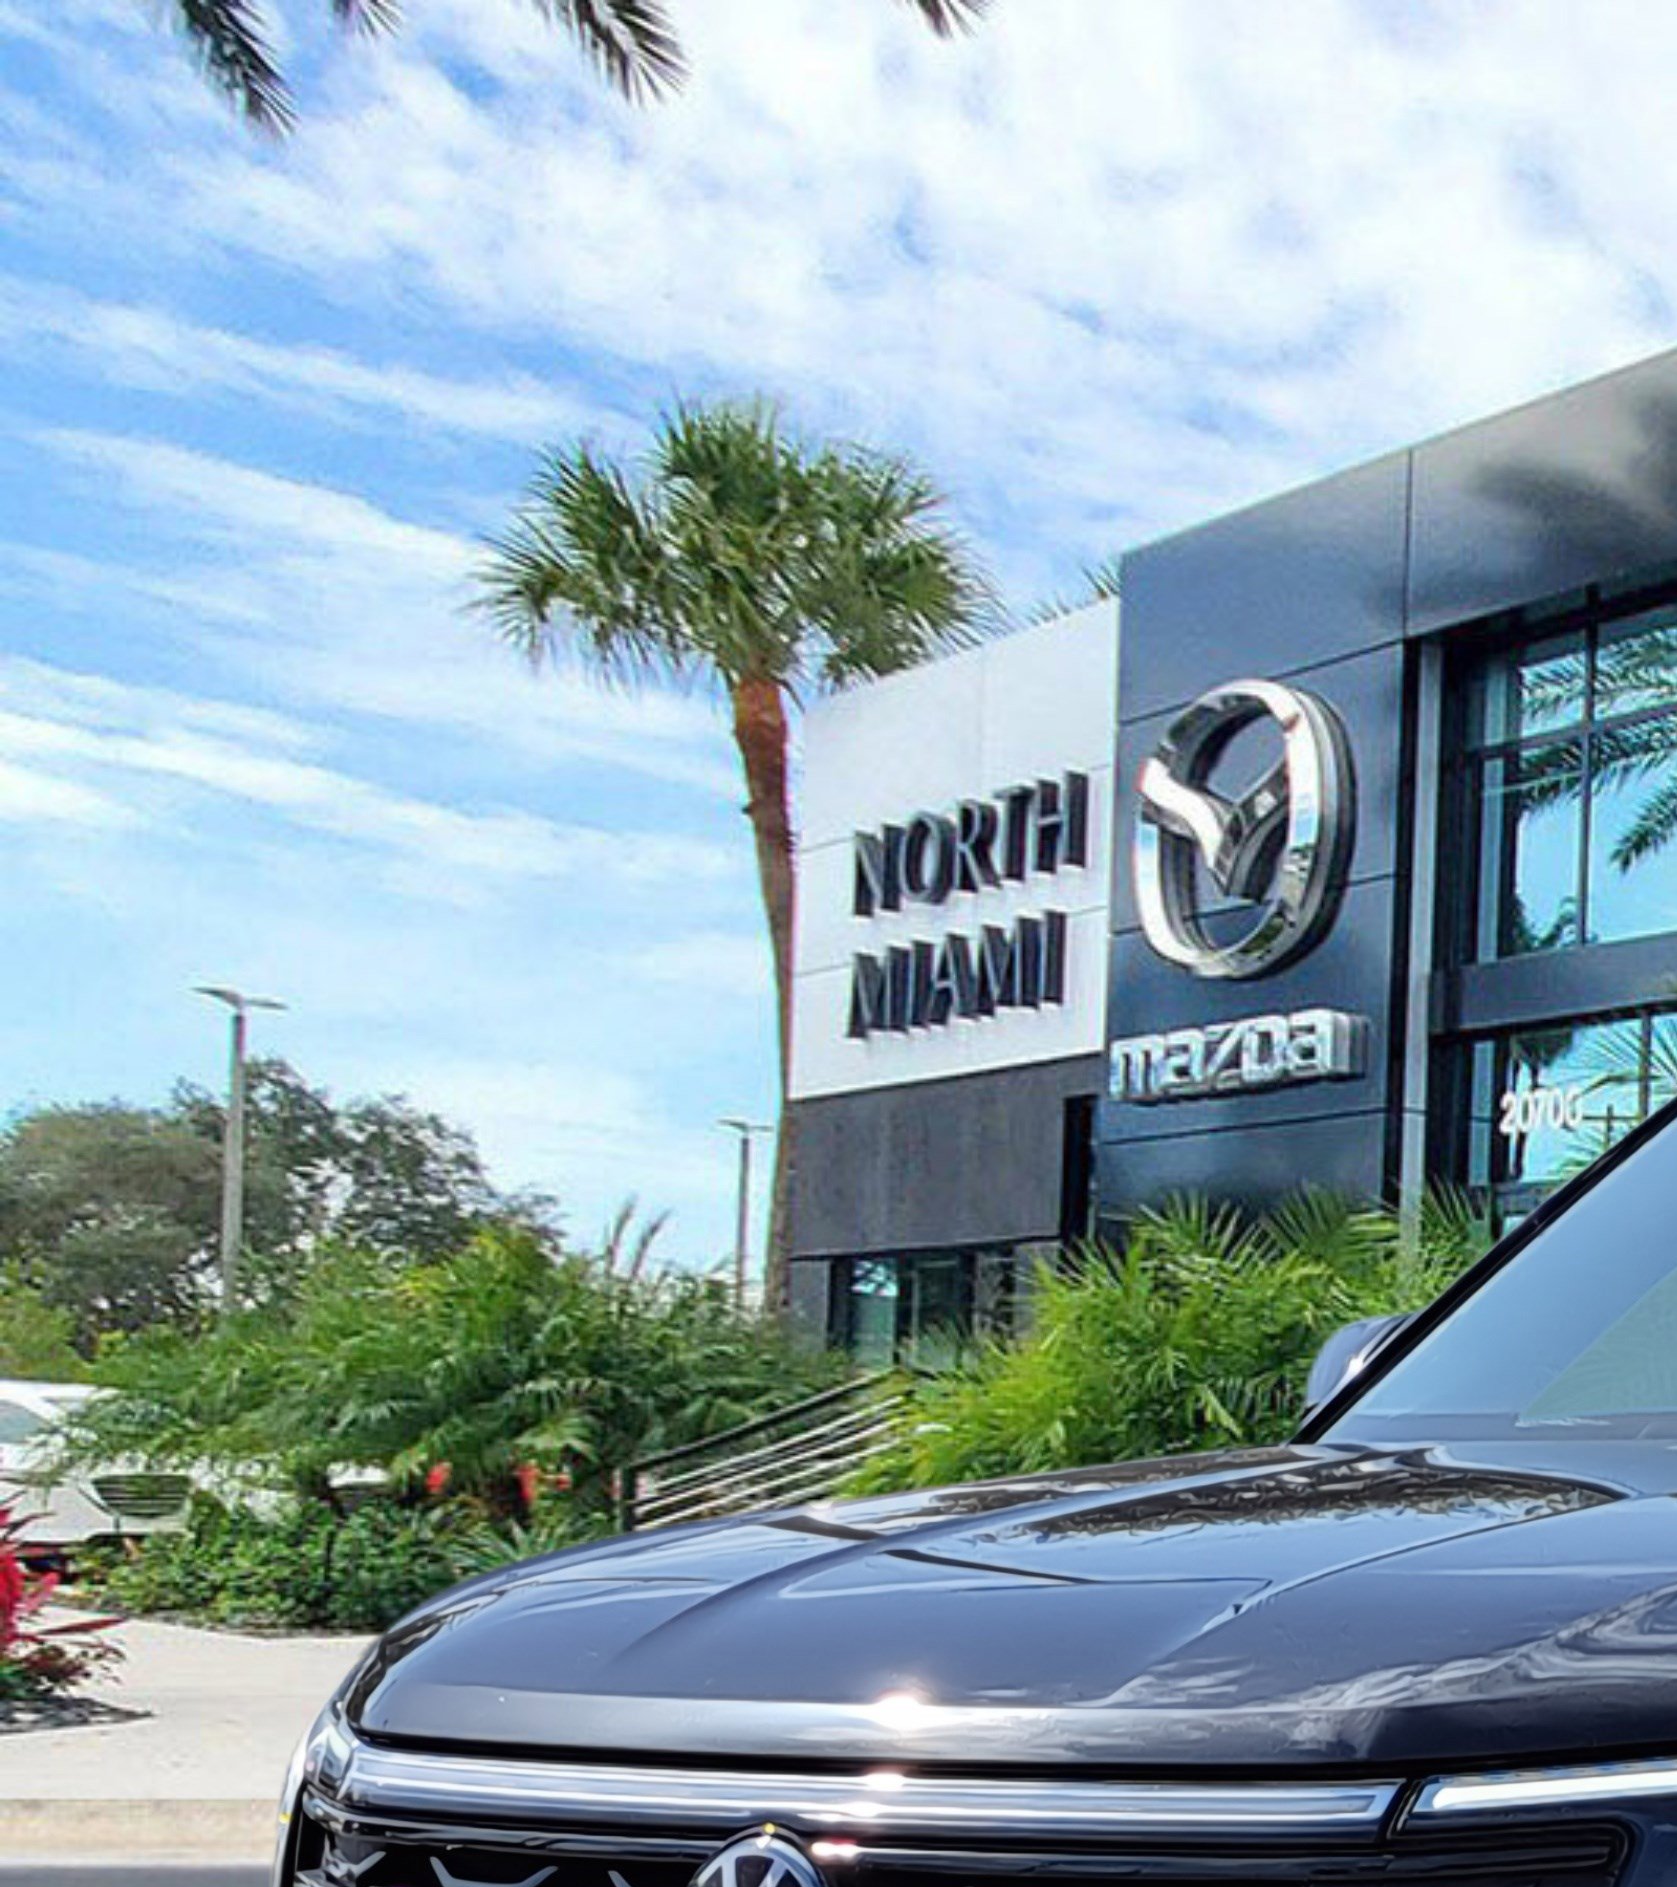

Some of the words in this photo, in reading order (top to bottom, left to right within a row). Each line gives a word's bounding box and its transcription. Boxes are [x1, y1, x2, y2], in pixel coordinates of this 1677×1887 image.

[853, 771, 1088, 918] NORTH
[846, 910, 1067, 1038] MIAMI
[1499, 1085, 1583, 1134] 20700
